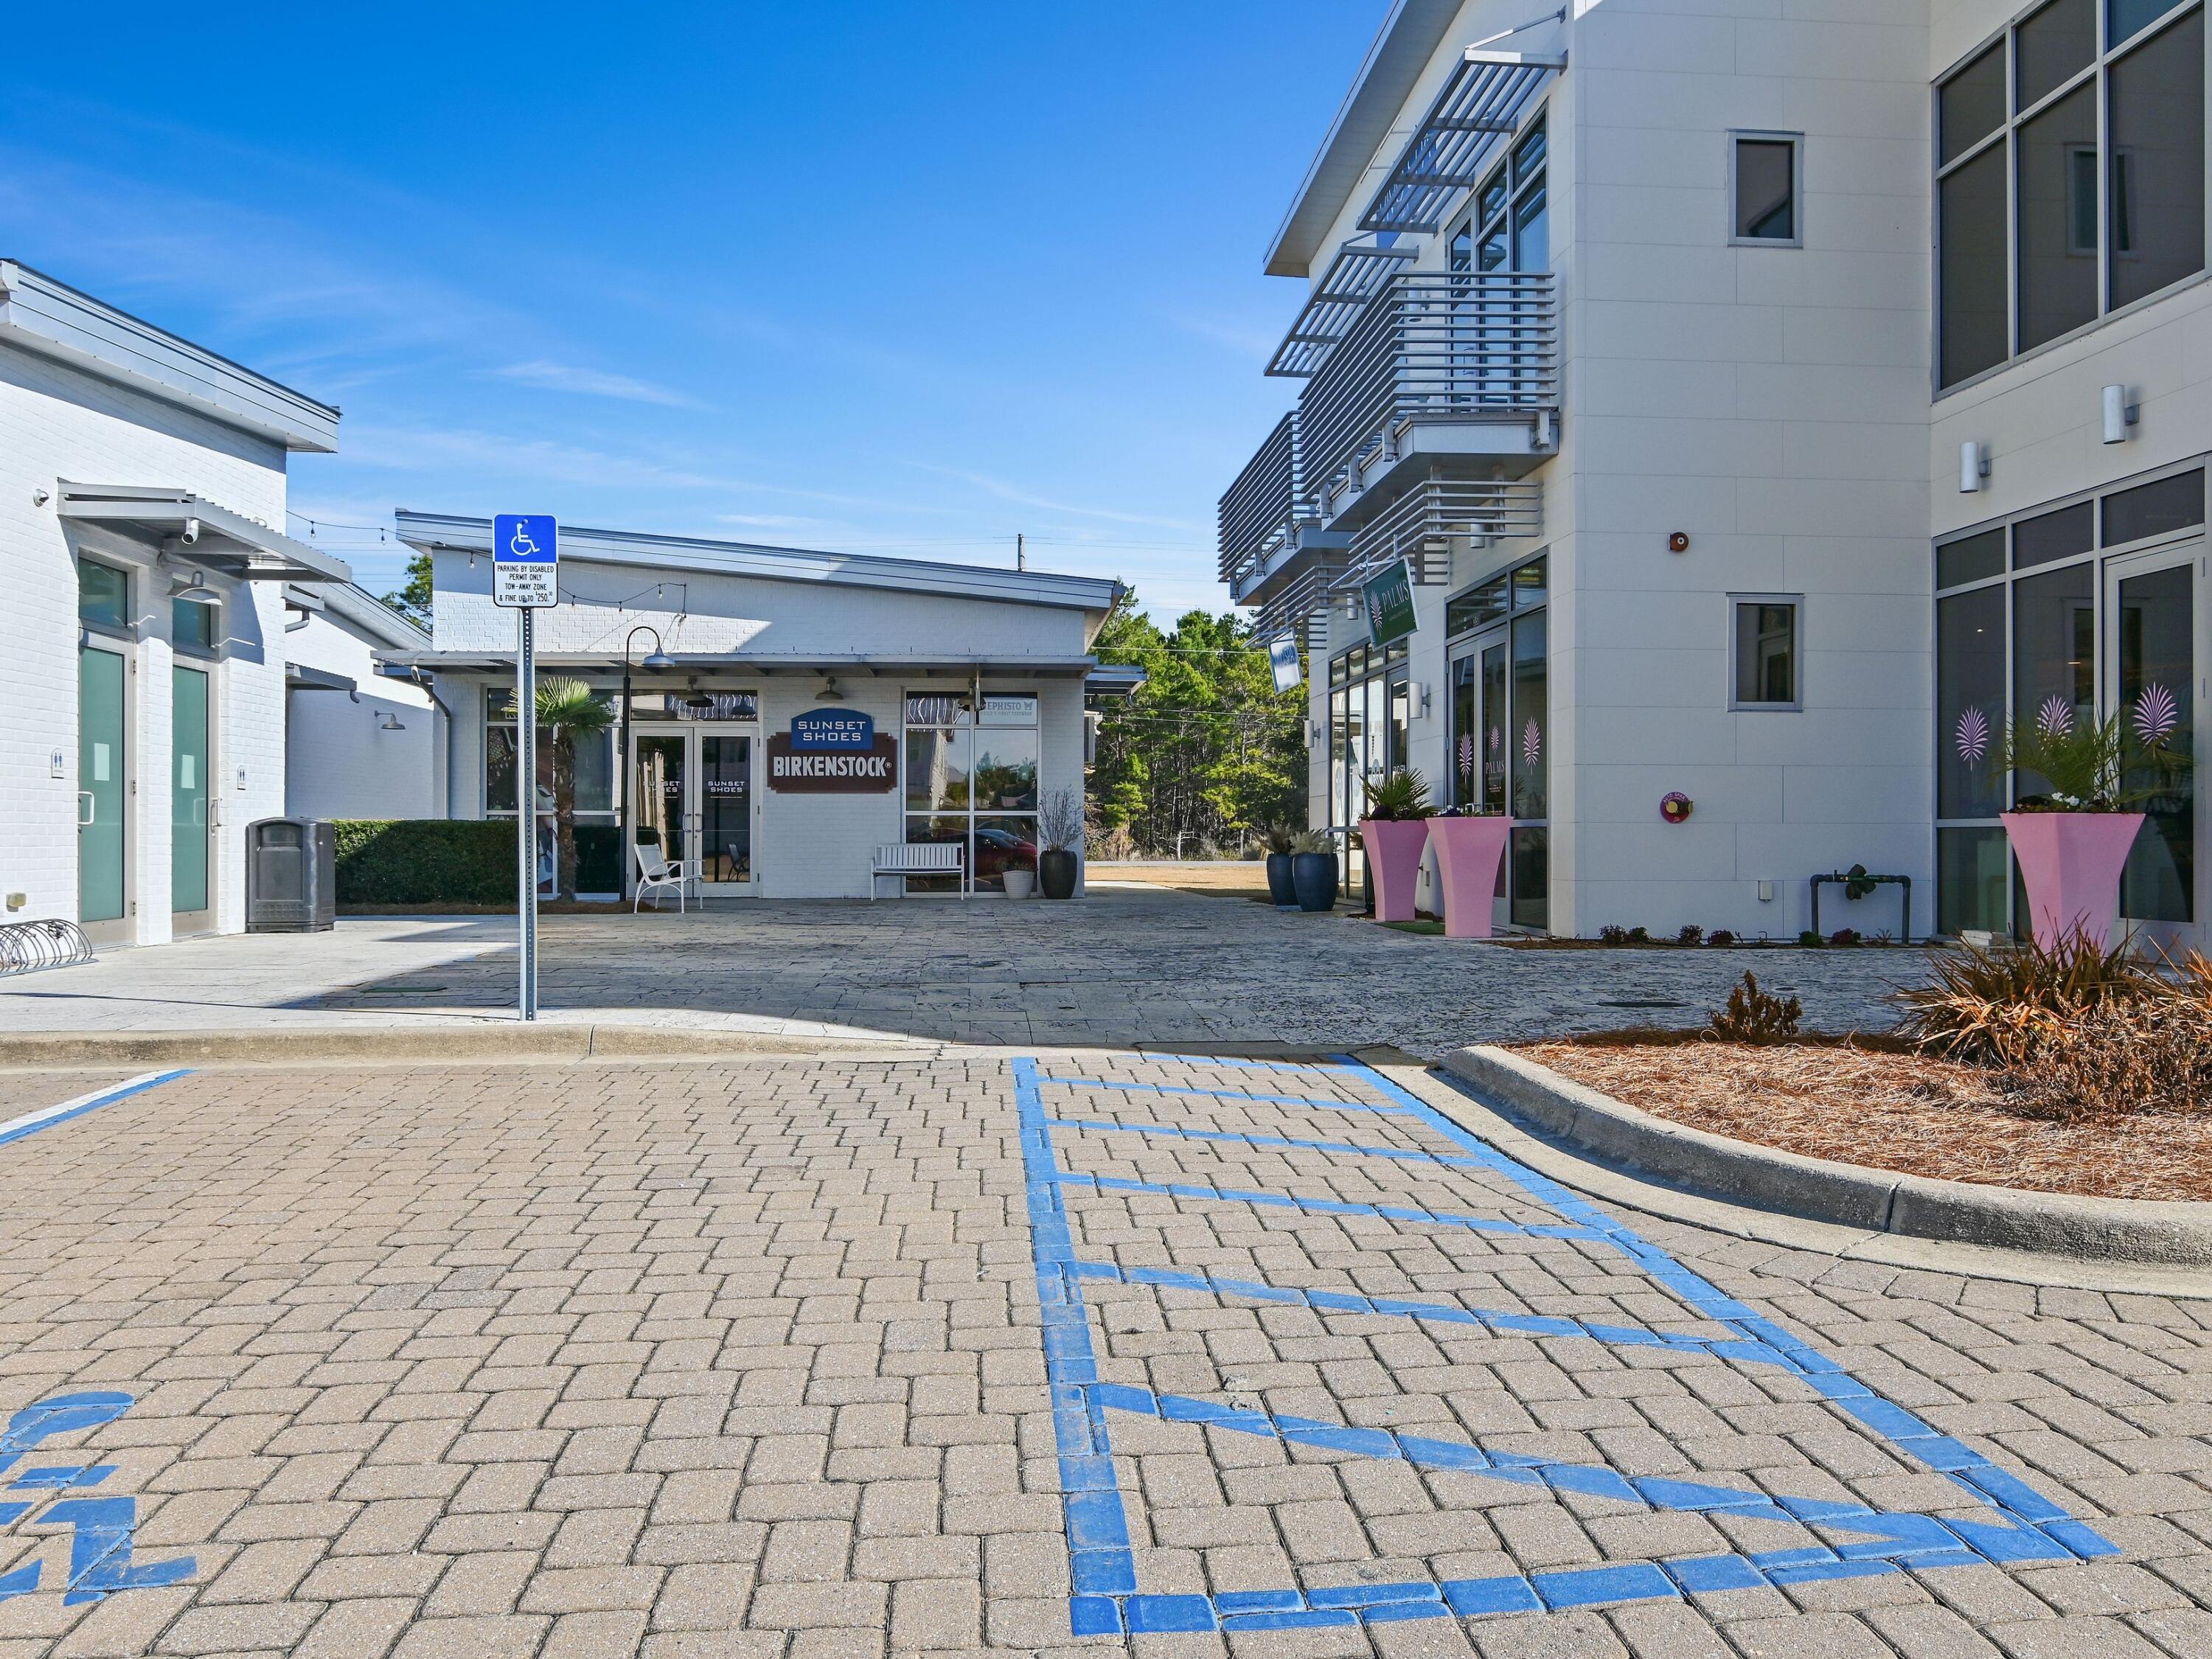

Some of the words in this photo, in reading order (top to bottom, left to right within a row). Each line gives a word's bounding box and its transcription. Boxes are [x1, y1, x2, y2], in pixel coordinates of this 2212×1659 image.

[1382, 580, 1410, 613] PALMS
[798, 721, 866, 730] SUNSET
[803, 732, 861, 741] SHOES
[773, 757, 886, 776] BIRKENSTOCK
[1486, 760, 1505, 774] PALMS
